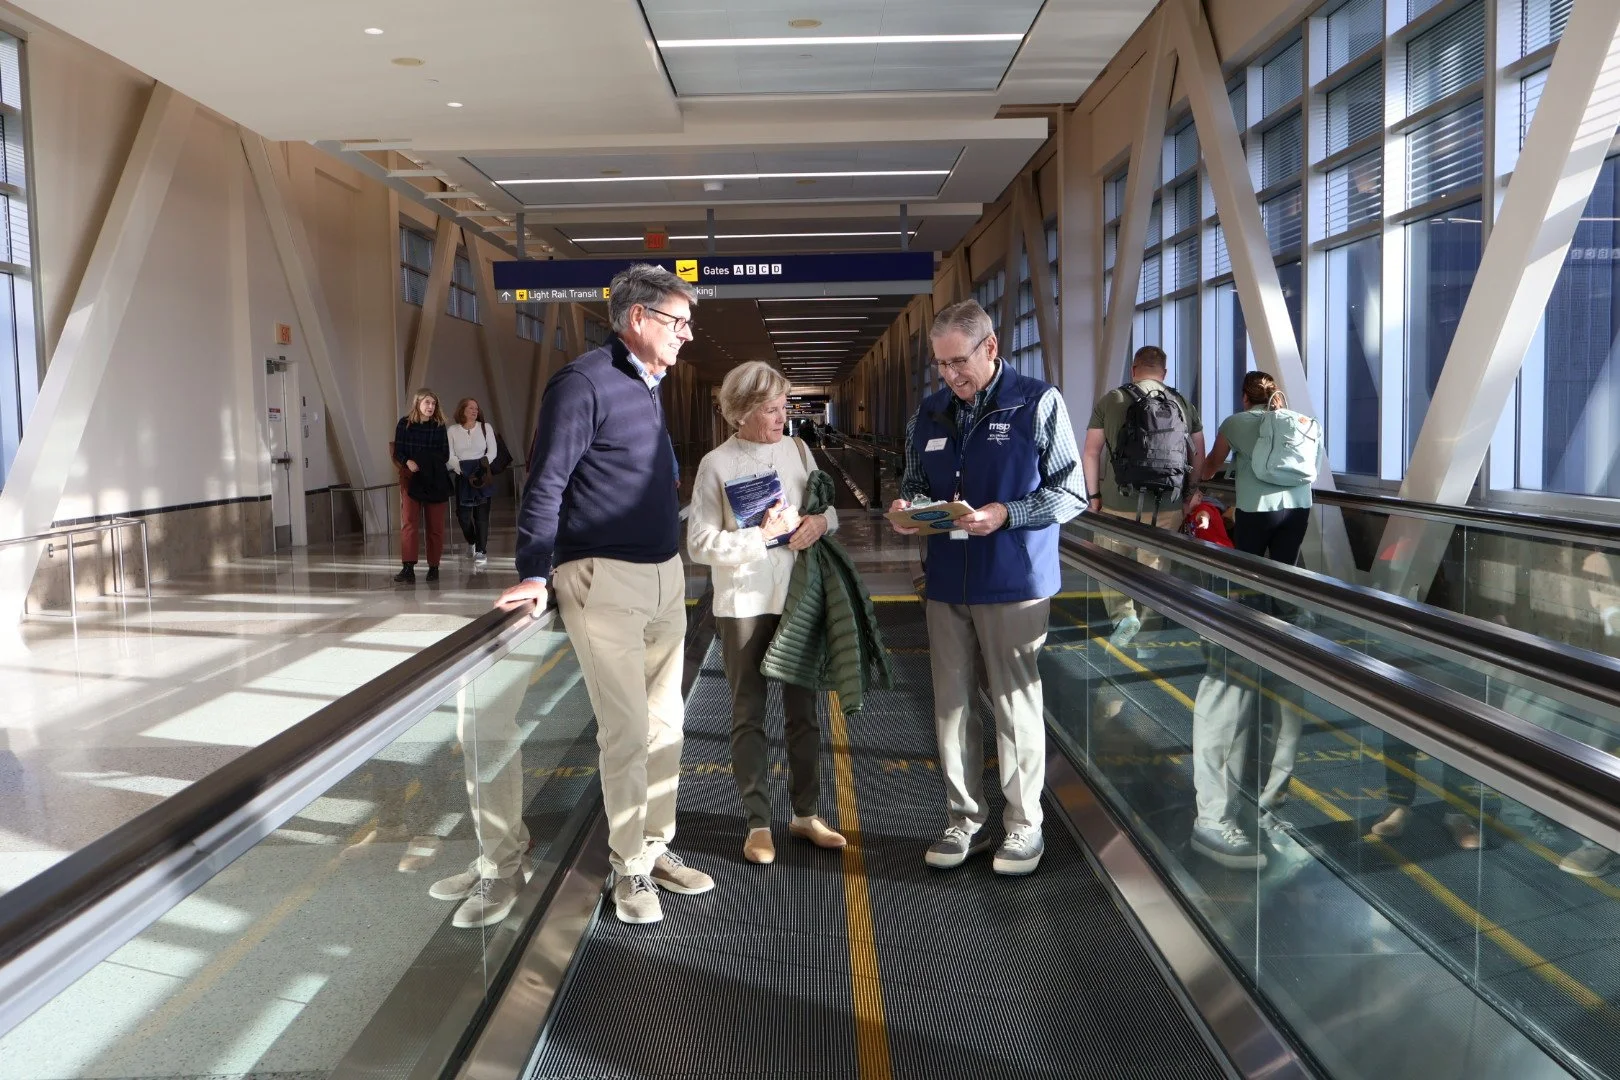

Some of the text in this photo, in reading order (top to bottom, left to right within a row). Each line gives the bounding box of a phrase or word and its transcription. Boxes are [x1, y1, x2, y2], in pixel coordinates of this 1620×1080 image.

[703, 264, 781, 275] Gates A B C D
[528, 286, 714, 300] Light Rail Transit king
[988, 422, 1011, 432] msp
